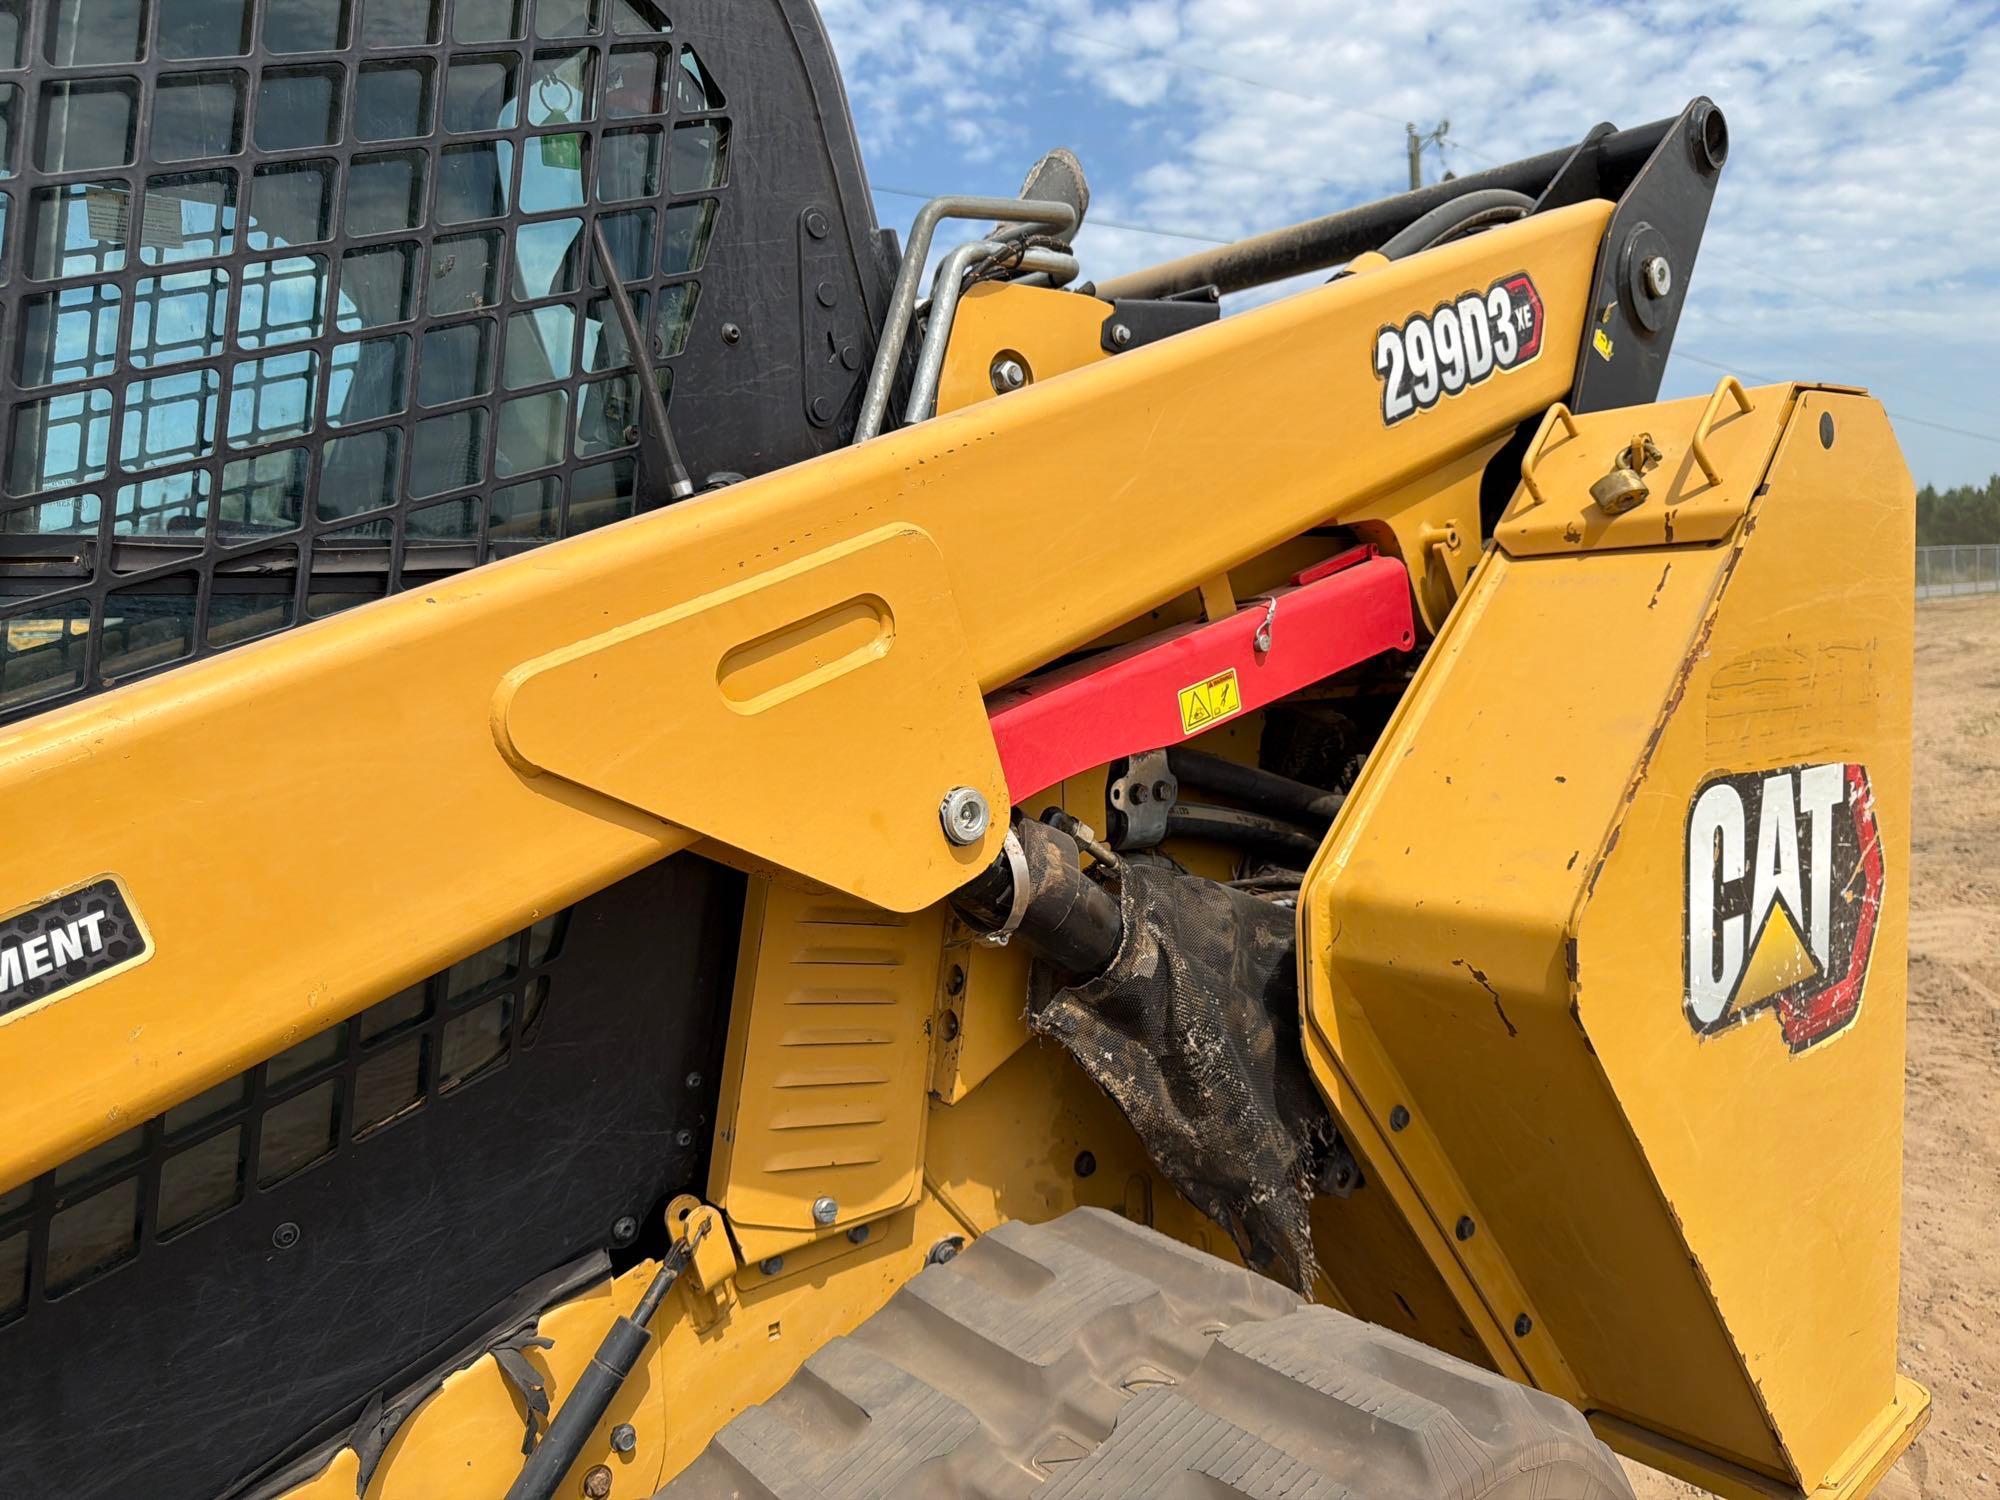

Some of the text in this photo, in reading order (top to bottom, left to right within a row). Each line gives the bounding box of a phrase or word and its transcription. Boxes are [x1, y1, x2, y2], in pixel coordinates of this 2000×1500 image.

[1377, 287, 1533, 419] 299D3 XE
[1689, 763, 1845, 1023] CAT
